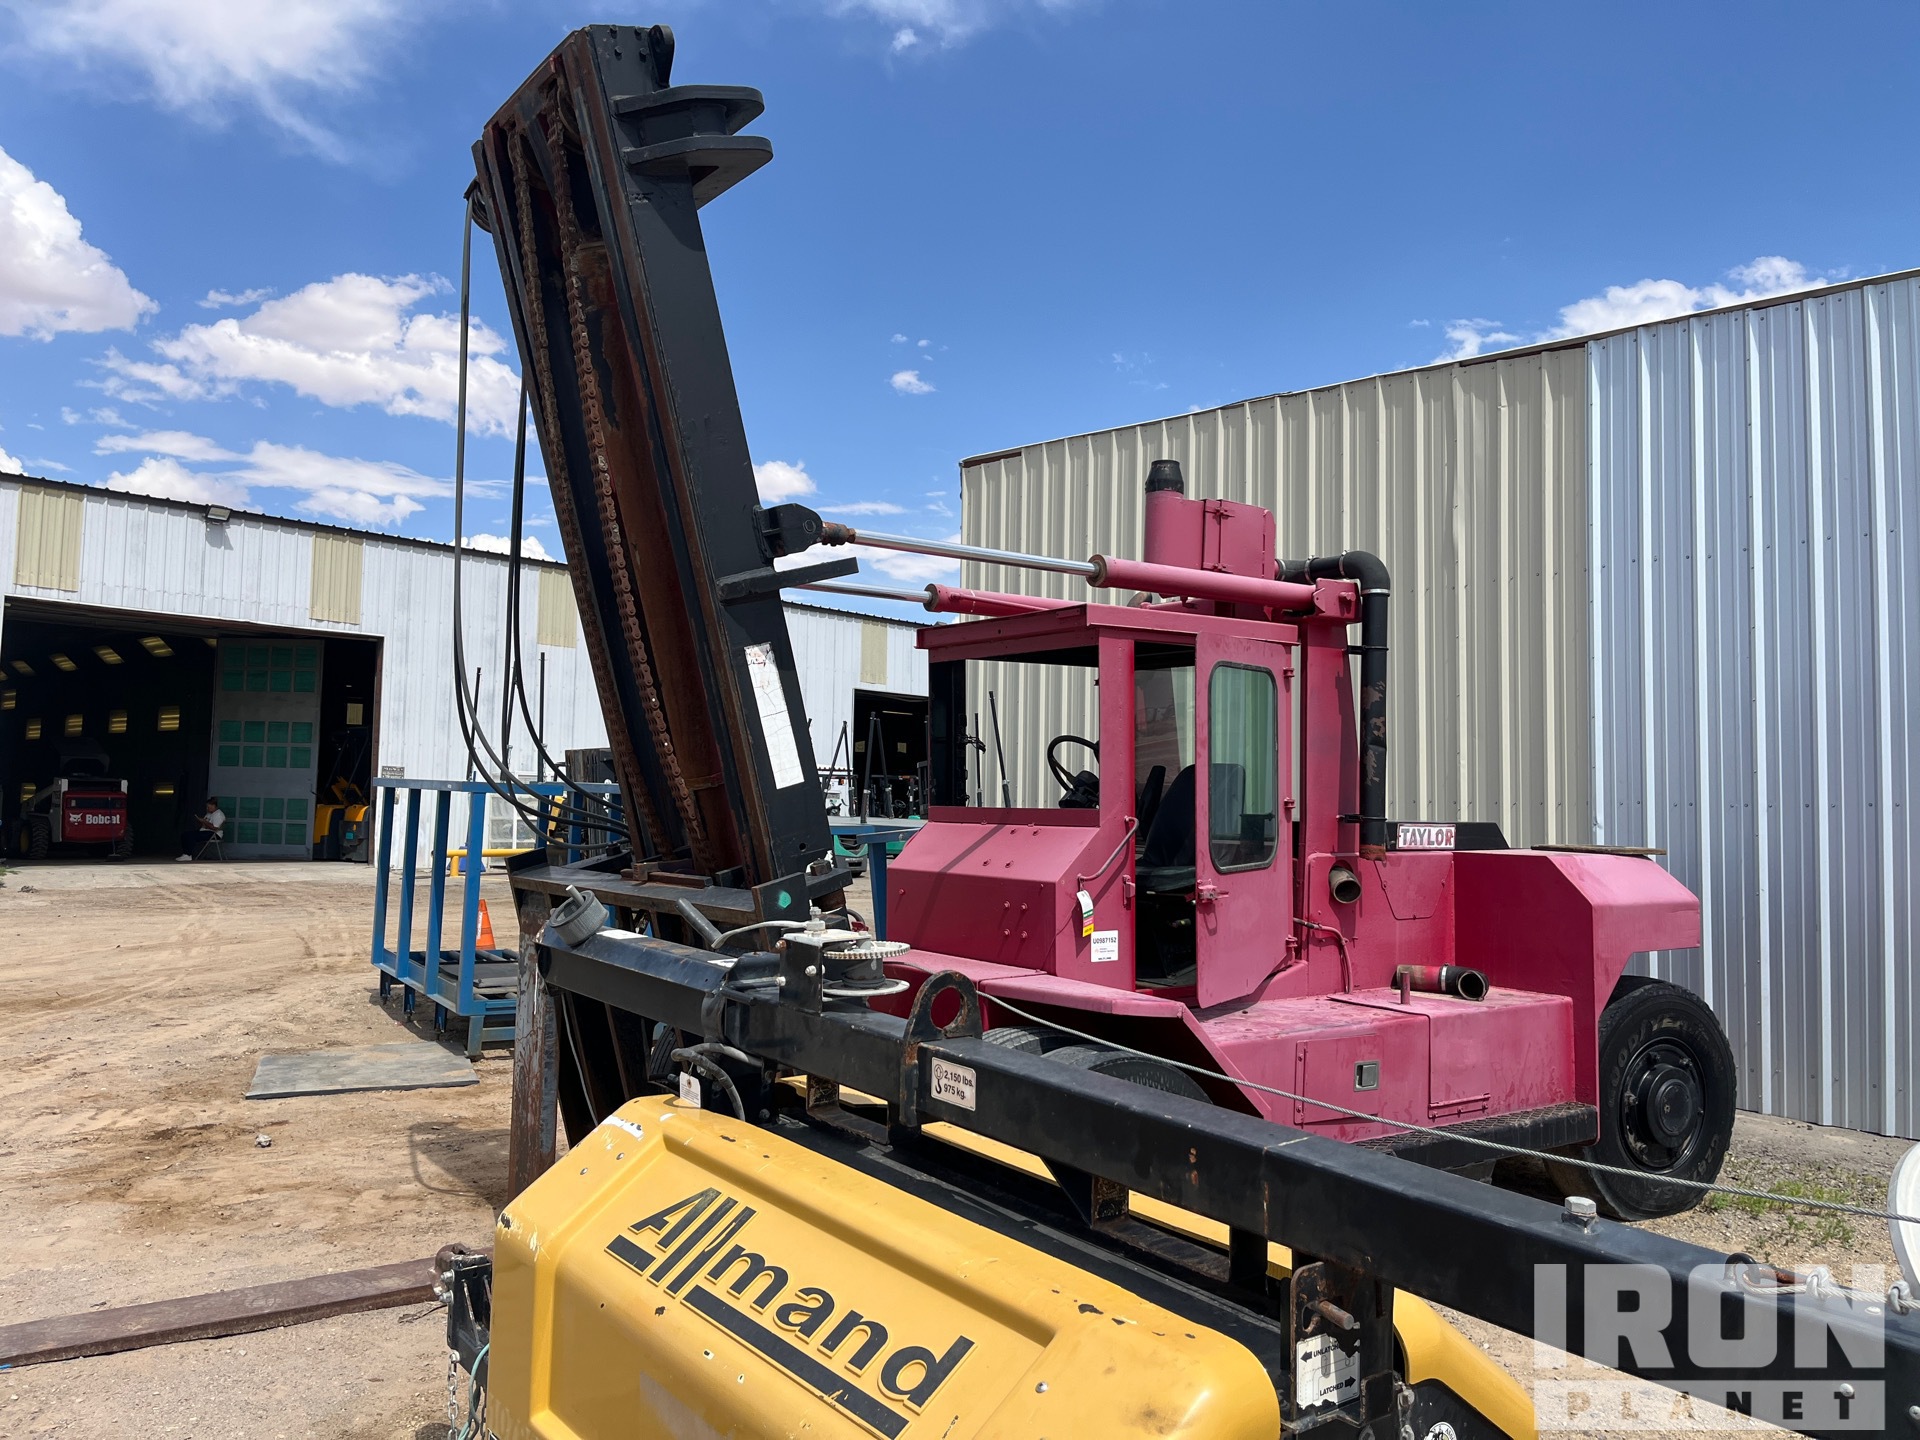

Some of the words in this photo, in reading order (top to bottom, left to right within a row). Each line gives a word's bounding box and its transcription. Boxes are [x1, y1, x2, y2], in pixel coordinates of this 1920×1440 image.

[86, 814, 120, 824] Bobcat
[1400, 828, 1454, 846] TAYLOR
[944, 1070, 961, 1083] 2,150
[963, 1075, 974, 1087] lbs.
[943, 1083, 956, 1095] 975
[956, 1087, 966, 1100] kg.
[628, 1187, 976, 1411] Allmand
[1320, 1382, 1344, 1396] LATCHED
